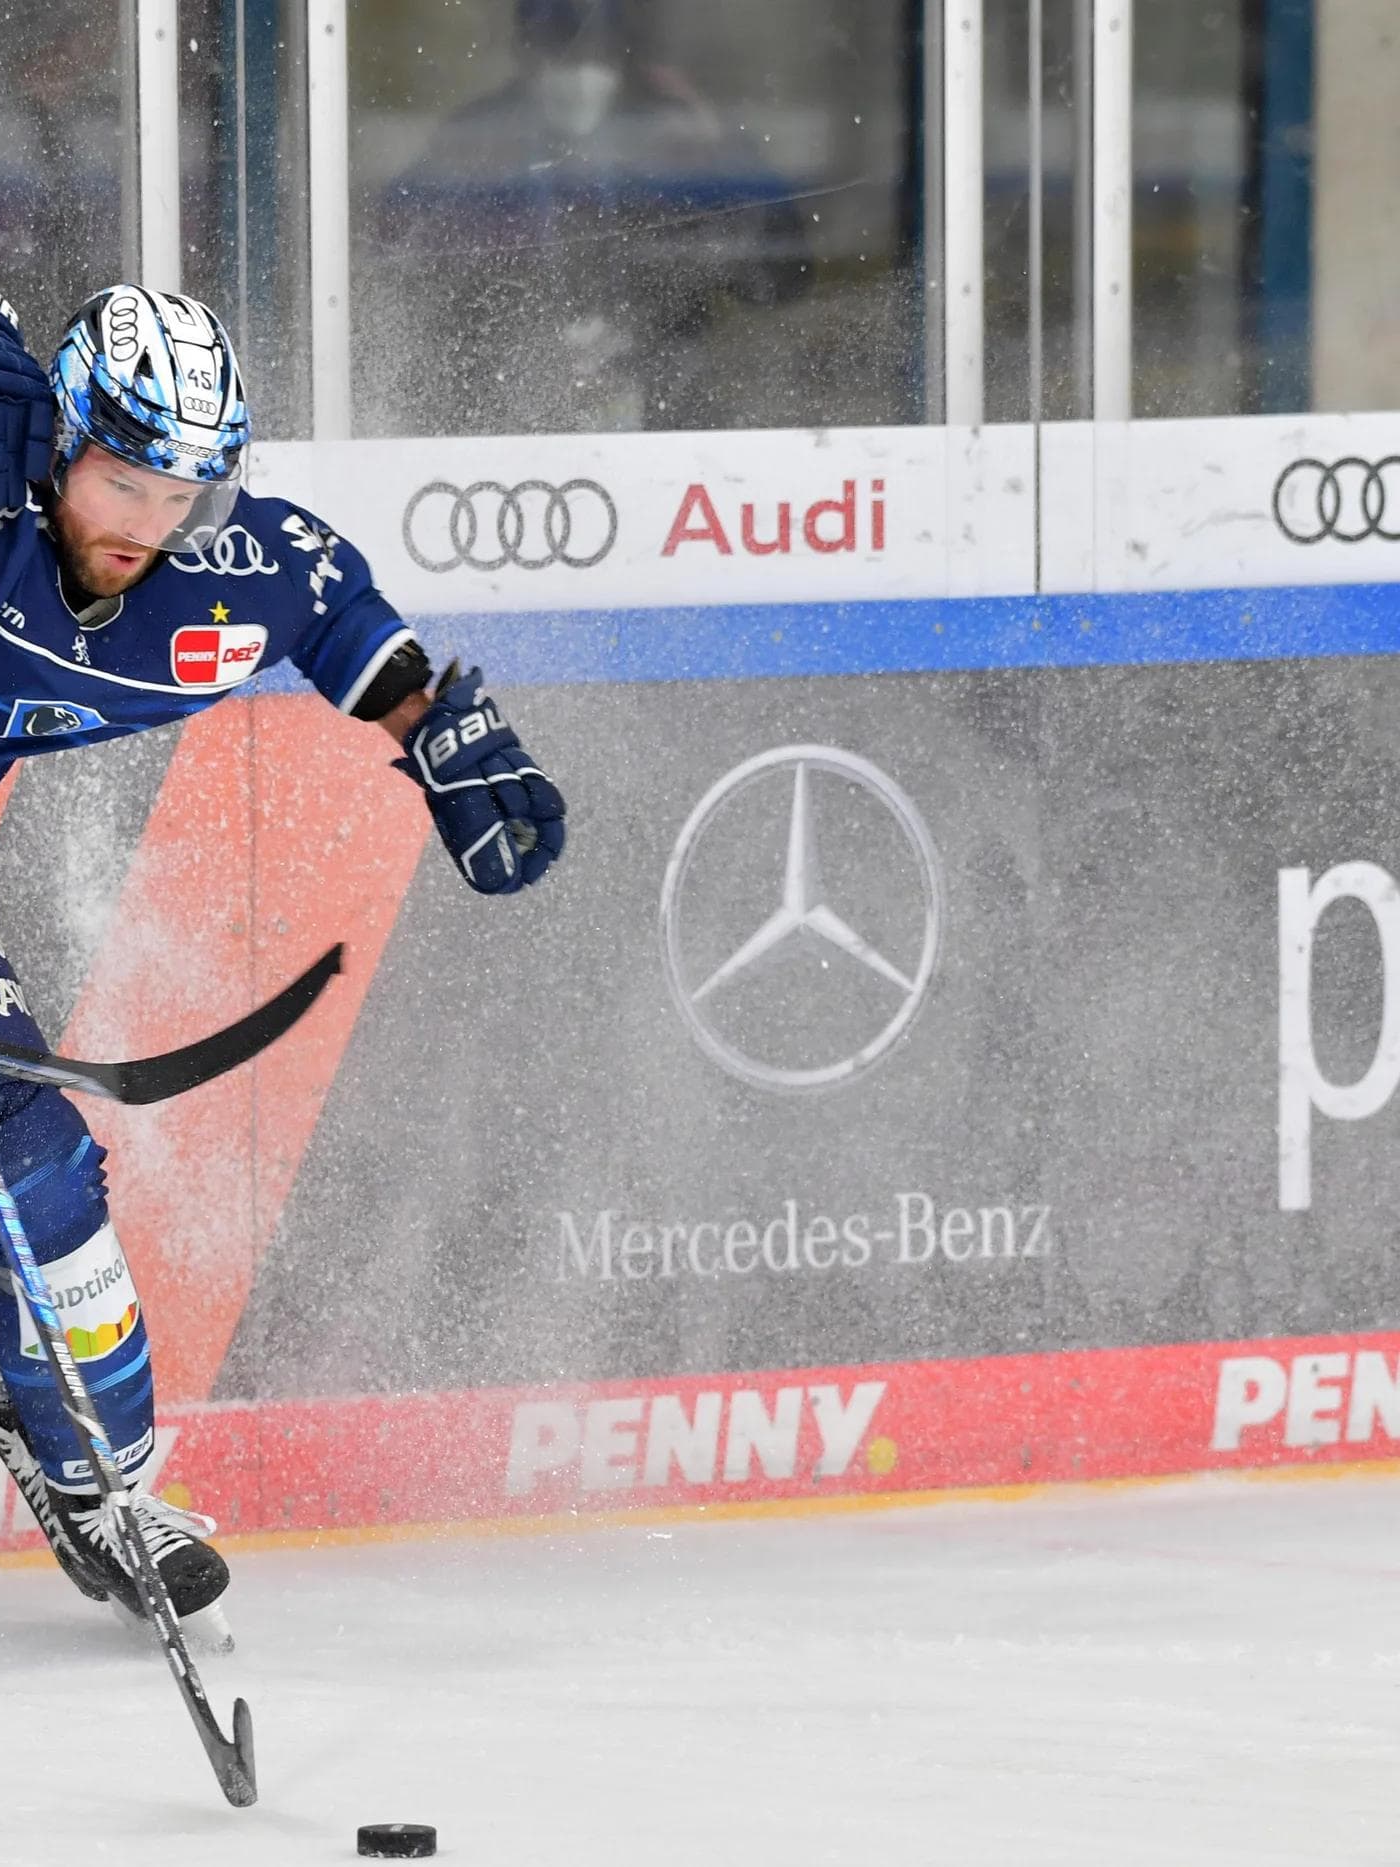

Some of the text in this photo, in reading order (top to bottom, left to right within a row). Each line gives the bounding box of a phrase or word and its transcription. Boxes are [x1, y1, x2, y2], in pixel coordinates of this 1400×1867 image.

[188, 368, 213, 391] 45
[660, 479, 885, 557] Audi
[555, 1191, 1053, 1283] Mercedes-Benz
